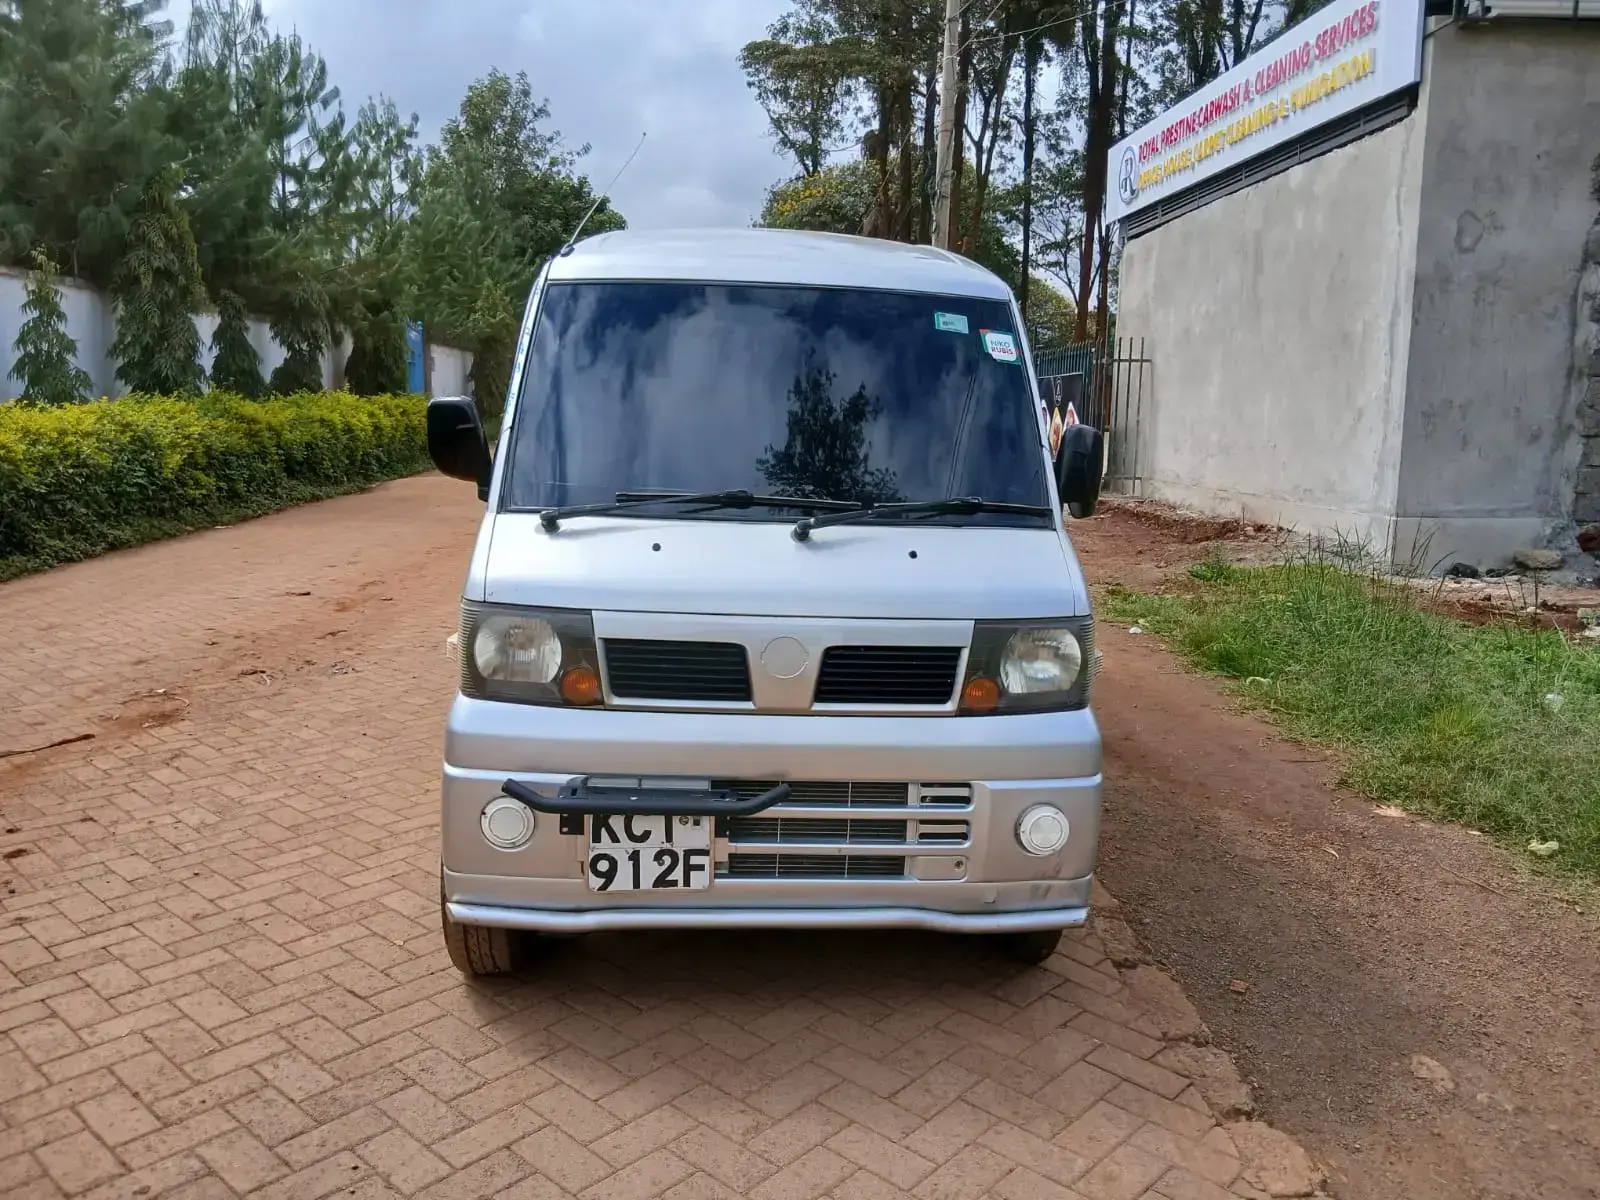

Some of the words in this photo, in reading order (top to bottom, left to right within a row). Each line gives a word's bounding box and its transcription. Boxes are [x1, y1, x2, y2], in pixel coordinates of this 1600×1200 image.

[1138, 135, 1159, 163] ROYAL
[1160, 110, 1197, 149] PRESTINE
[1197, 81, 1241, 128] CARWASH
[1243, 78, 1250, 101] &
[1254, 41, 1310, 95] CLEANING
[1315, 0, 1376, 61] SERVICES
[1226, 101, 1276, 144] CLEANING
[1290, 48, 1376, 112] FUMIGATION
[589, 849, 710, 891] 912F
